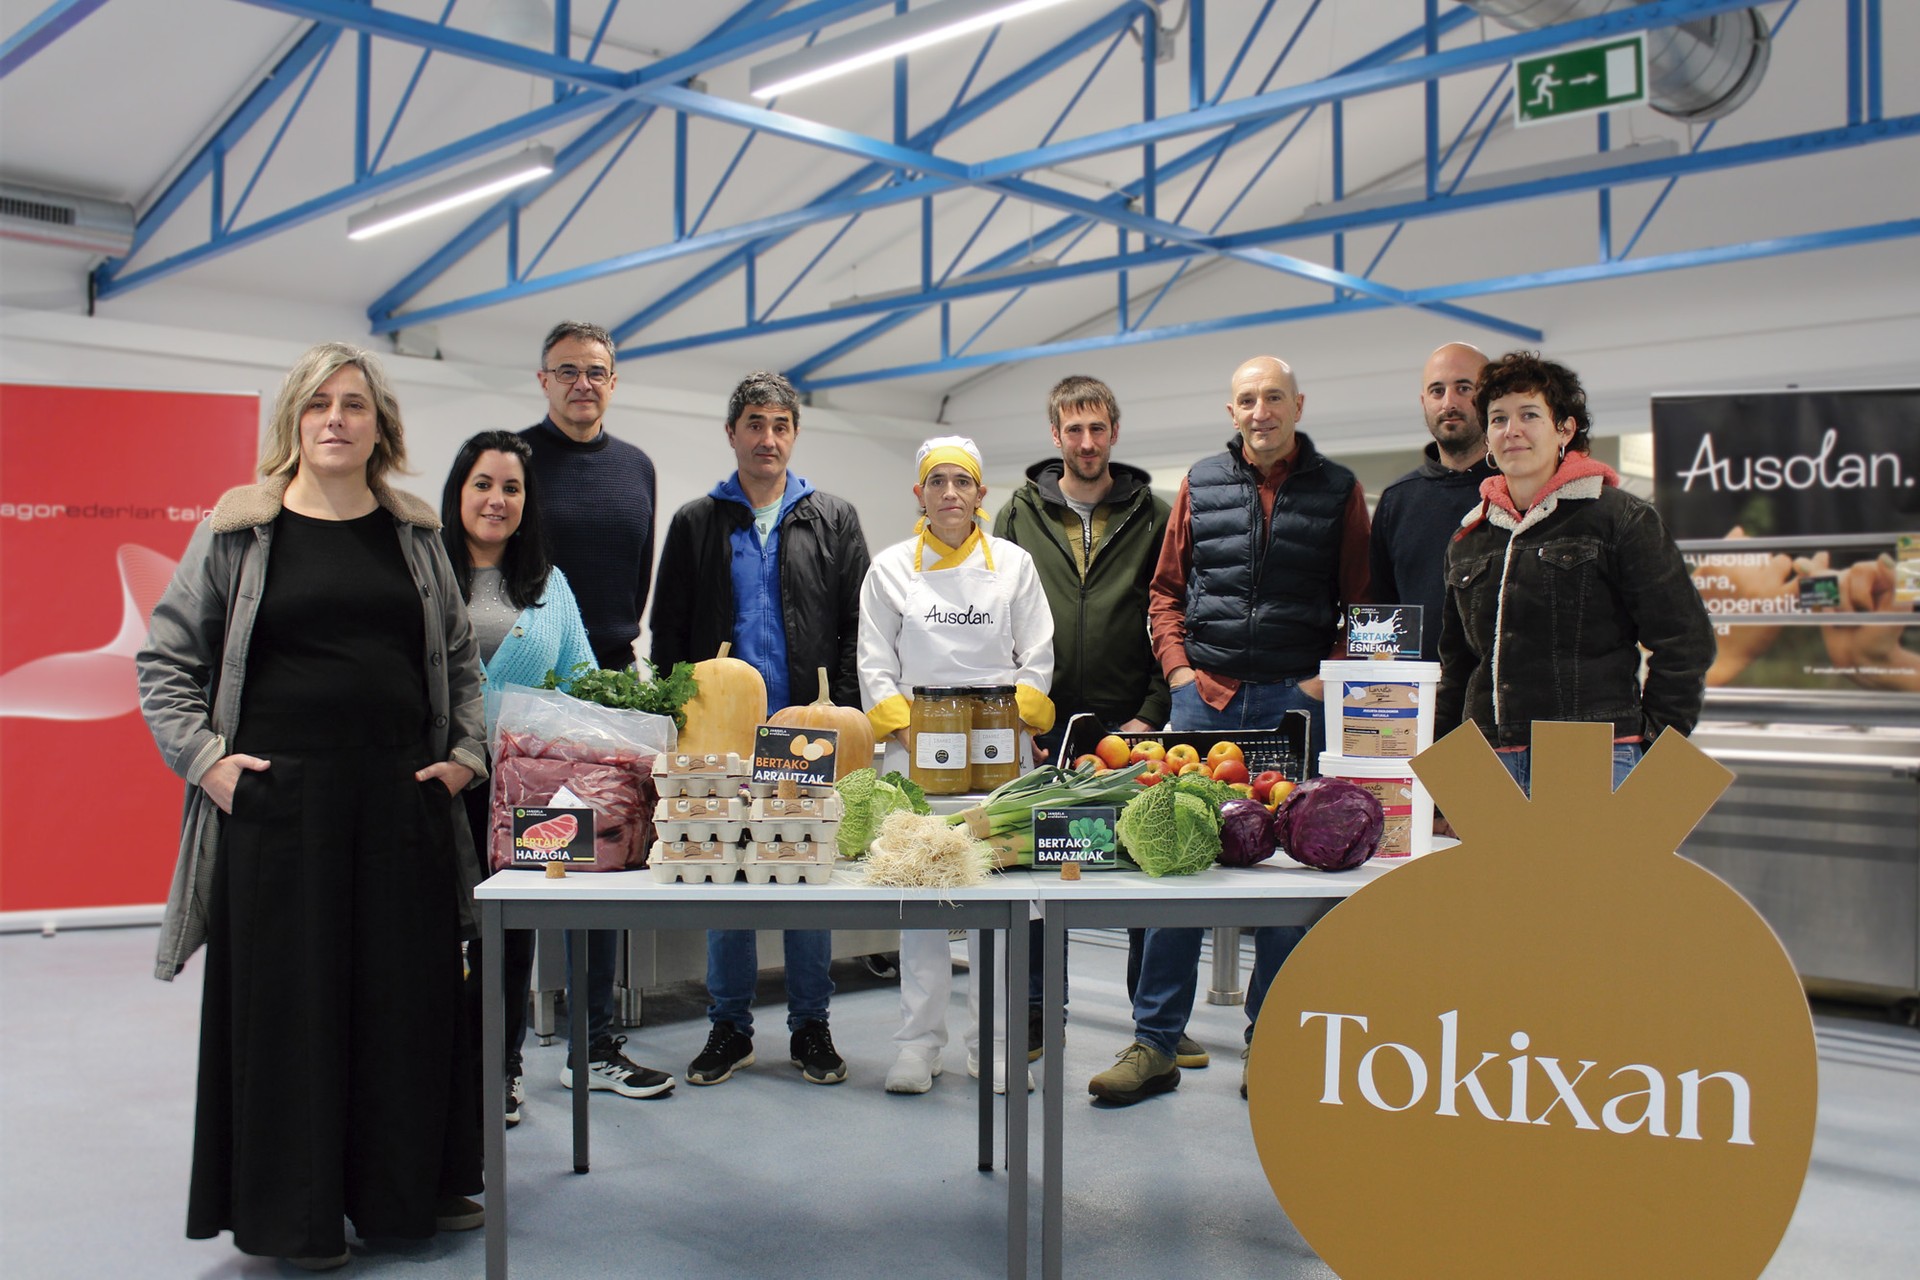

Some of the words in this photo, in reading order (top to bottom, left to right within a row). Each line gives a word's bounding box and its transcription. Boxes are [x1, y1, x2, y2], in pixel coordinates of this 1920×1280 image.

[1676, 428, 1915, 492] Ausolan.
[1690, 575, 1736, 592] ara,
[924, 604, 994, 625] Ausolan.
[1350, 643, 1400, 653] ESNEKIAK
[755, 757, 809, 770] BERTAKO
[754, 770, 825, 784] ARRAUTZAK
[515, 837, 569, 848] BERTAKO
[1038, 838, 1091, 848] BERTAKO
[516, 850, 570, 861] HARAGIA
[1038, 851, 1104, 861] BARAZKIAK
[1301, 1010, 1754, 1145] Tokixan
